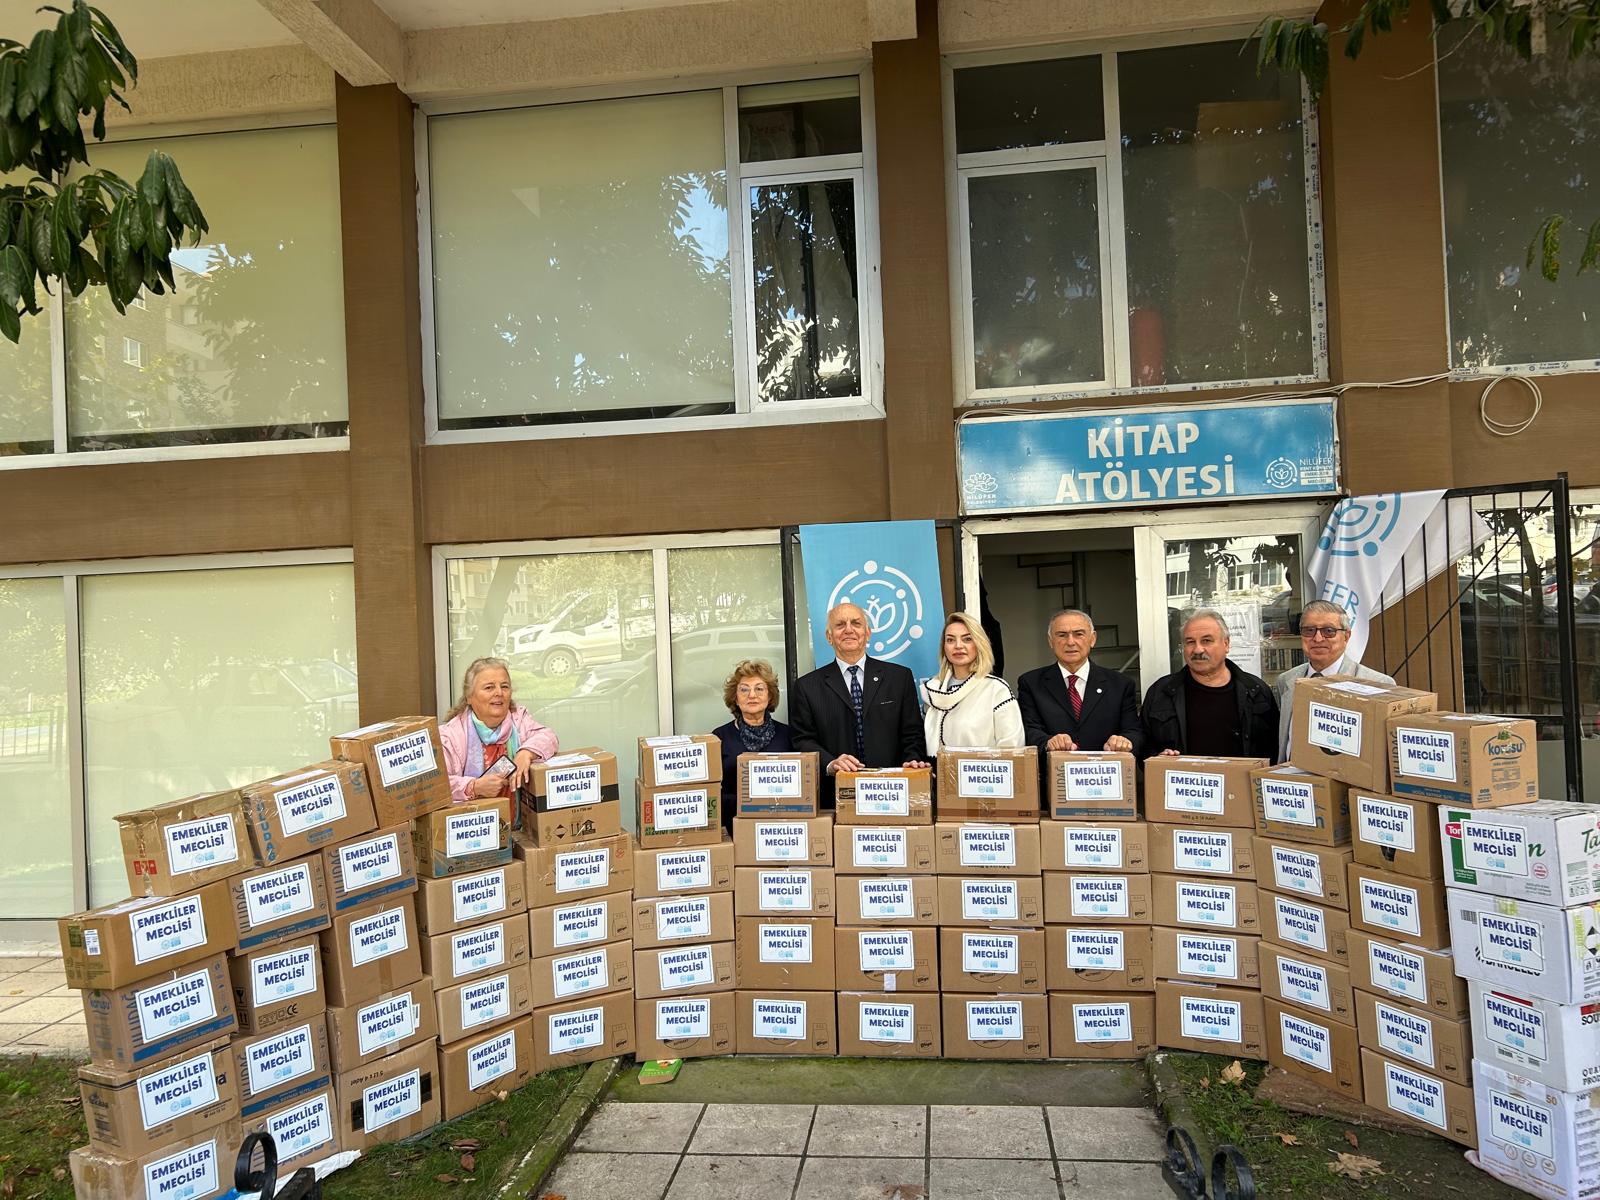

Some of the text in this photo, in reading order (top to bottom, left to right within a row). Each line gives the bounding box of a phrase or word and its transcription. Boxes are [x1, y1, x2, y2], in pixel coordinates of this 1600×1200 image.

[1087, 417, 1200, 459] KİTAP
[1054, 454, 1236, 504] ATÖLYESİ
[1314, 709, 1358, 726] EMEKLİLER
[1317, 722, 1351, 738] MECLİSİ
[380, 735, 426, 759] EMEKLİLER
[1402, 734, 1449, 748] EMEKLİLER
[389, 748, 425, 770] MECLİSİ
[658, 746, 703, 761] EMEKLİLER
[1408, 749, 1444, 762] MECLİSİ
[664, 757, 698, 771] MECLİSİ
[753, 762, 797, 775] EMEKLİLER
[962, 763, 1009, 774] EMEKLİLER
[1069, 764, 1117, 776] EMEKLİLER
[550, 769, 596, 783] EMEKLİLER
[758, 773, 792, 785] MECLİSİ
[968, 773, 1004, 784] MECLİSİ
[1075, 775, 1112, 787] MECLİSİ
[1170, 776, 1219, 787] EMEKLİLER
[282, 782, 335, 806] EMEKLİLER
[556, 780, 592, 794] MECLİSİ
[859, 781, 904, 792] EMEKLİLER
[1175, 787, 1213, 799] MECLİSİ
[1266, 785, 1309, 797] EMEKLİLER
[658, 793, 703, 806] EMEKLİLER
[864, 791, 900, 802] MECLİSİ
[1272, 797, 1305, 809] MECLİSİ
[291, 796, 332, 817] MECLİSİ
[664, 803, 698, 816] MECLİSİ
[1362, 804, 1408, 820] EMEKLİLER
[451, 815, 495, 829] EMEKLİLER
[1368, 818, 1404, 832] MECLİSİ
[172, 821, 228, 841] EMEKLİLER
[456, 827, 488, 840] MECLİSİ
[760, 827, 803, 835] EMEKLİLER
[857, 833, 901, 842] EMEKLİLER
[965, 830, 1010, 840] EMEKLİLER
[1070, 832, 1116, 842] EMEKLİLER
[1466, 826, 1522, 843] EMEKLİLER
[180, 836, 224, 854] MECLİSİ
[764, 837, 800, 847] MECLİSİ
[862, 842, 898, 853] MECLİSİ
[970, 842, 1005, 851] MECLİSİ
[1075, 842, 1112, 853] MECLİSİ
[1178, 836, 1227, 846] EMEKLİLER
[345, 841, 393, 861] EMEKLİLER
[1184, 847, 1222, 858] MECLİSİ
[1473, 842, 1517, 857] MECLİSİ
[352, 854, 390, 872] MECLİSİ
[560, 854, 605, 867] EMEKLİLER
[661, 854, 706, 866] EMEKLİLER
[1276, 852, 1316, 868] EMEKLİLER
[565, 864, 600, 878] MECLİSİ
[667, 863, 702, 876] MECLİSİ
[1281, 865, 1313, 879] MECLİSİ
[250, 871, 304, 893] EMEKLİLER
[457, 876, 500, 893] EMEKLİLER
[258, 883, 301, 906] MECLİSİ
[463, 888, 496, 905] MECLİSİ
[137, 904, 196, 929] EMEKLİLER
[661, 903, 705, 915] EMEKLİLER
[354, 914, 400, 936] EMEKLİLER
[666, 913, 701, 925] MECLİSİ
[146, 919, 192, 941] MECLİSİ
[764, 929, 807, 937] EMEKLİLER
[1482, 917, 1538, 938] EMEKLİLER
[361, 926, 397, 947] MECLİSİ
[768, 938, 802, 948] MECLİSİ
[864, 934, 908, 945] EMEKLİLER
[967, 938, 1013, 948] EMEKLİLER
[1072, 934, 1119, 944] EMEKLİLER
[1489, 933, 1533, 952] MECLİSİ
[869, 945, 904, 956] MECLİSİ
[1077, 945, 1114, 955] MECLİSİ
[1182, 940, 1232, 952] EMEKLİLER
[663, 951, 707, 965] EMEKLİLER
[972, 949, 1008, 959] MECLİSİ
[1188, 952, 1226, 963] MECLİSİ
[1373, 948, 1420, 971] EMEKLİLER
[258, 953, 310, 974] EMEKLİLER
[558, 956, 602, 972] EMEKLİLER
[669, 960, 704, 975] MECLİSİ
[264, 965, 305, 986] MECLİSİ
[563, 966, 598, 982] MECLİSİ
[1281, 963, 1323, 981] EMEKLİLER
[1379, 963, 1416, 983] MECLİSİ
[465, 982, 505, 1000] EMEKLİLER
[1287, 976, 1320, 993] MECLİSİ
[143, 978, 205, 1007] EMEKLİLER
[153, 991, 201, 1019] MECLİSİ
[470, 992, 501, 1011] MECLİSİ
[661, 1003, 706, 1014] EMEKLİLER
[758, 1004, 802, 1014] EMEKLİLER
[1186, 1003, 1236, 1015] EMEKLİLER
[361, 1000, 408, 1024] EMEKLİLER
[864, 1006, 909, 1017] EMEKLİLER
[971, 1005, 1017, 1015] EMEKLİLER
[1078, 1006, 1125, 1017] EMEKLİLER
[1486, 999, 1541, 1027] EMEKLİLER
[368, 1011, 404, 1034] MECLİSİ
[554, 1013, 599, 1028] EMEKLİLER
[666, 1013, 700, 1025] MECLİSİ
[763, 1015, 797, 1025] MECLİSİ
[869, 1018, 904, 1028] MECLİSİ
[977, 1016, 1013, 1026] MECLİSİ
[1084, 1017, 1121, 1028] MECLİSİ
[1191, 1014, 1230, 1026] MECLİSİ
[1380, 1009, 1427, 1035] EMEKLİLER
[559, 1023, 594, 1038] MECLİSİ
[1284, 1019, 1326, 1042] EMEKLİLER
[1386, 1024, 1423, 1045] MECLİSİ
[1493, 1015, 1536, 1040] MECLİSİ
[252, 1033, 306, 1061] EMEKLİLER
[472, 1038, 511, 1062] EMEKLİLER
[1289, 1033, 1322, 1053] MECLİSİ
[260, 1045, 302, 1072] MECLİSİ
[477, 1048, 507, 1072] MECLİSİ
[145, 1061, 207, 1094] EMEKLİLER
[1389, 1070, 1438, 1097] EMEKLİLER
[154, 1074, 203, 1106] MECLİSİ
[369, 1076, 415, 1102] EMEKLİLER
[1396, 1085, 1435, 1108] MECLİSİ
[374, 1088, 411, 1113] MECLİSİ
[273, 1102, 324, 1132] EMEKLİLER
[1493, 1095, 1550, 1125] EMEKLİLER
[280, 1115, 320, 1143] MECLİSİ
[1500, 1112, 1543, 1138] MECLİSİ
[151, 1148, 211, 1180] EMEKLİLER
[159, 1163, 206, 1193] MECLİSİ
